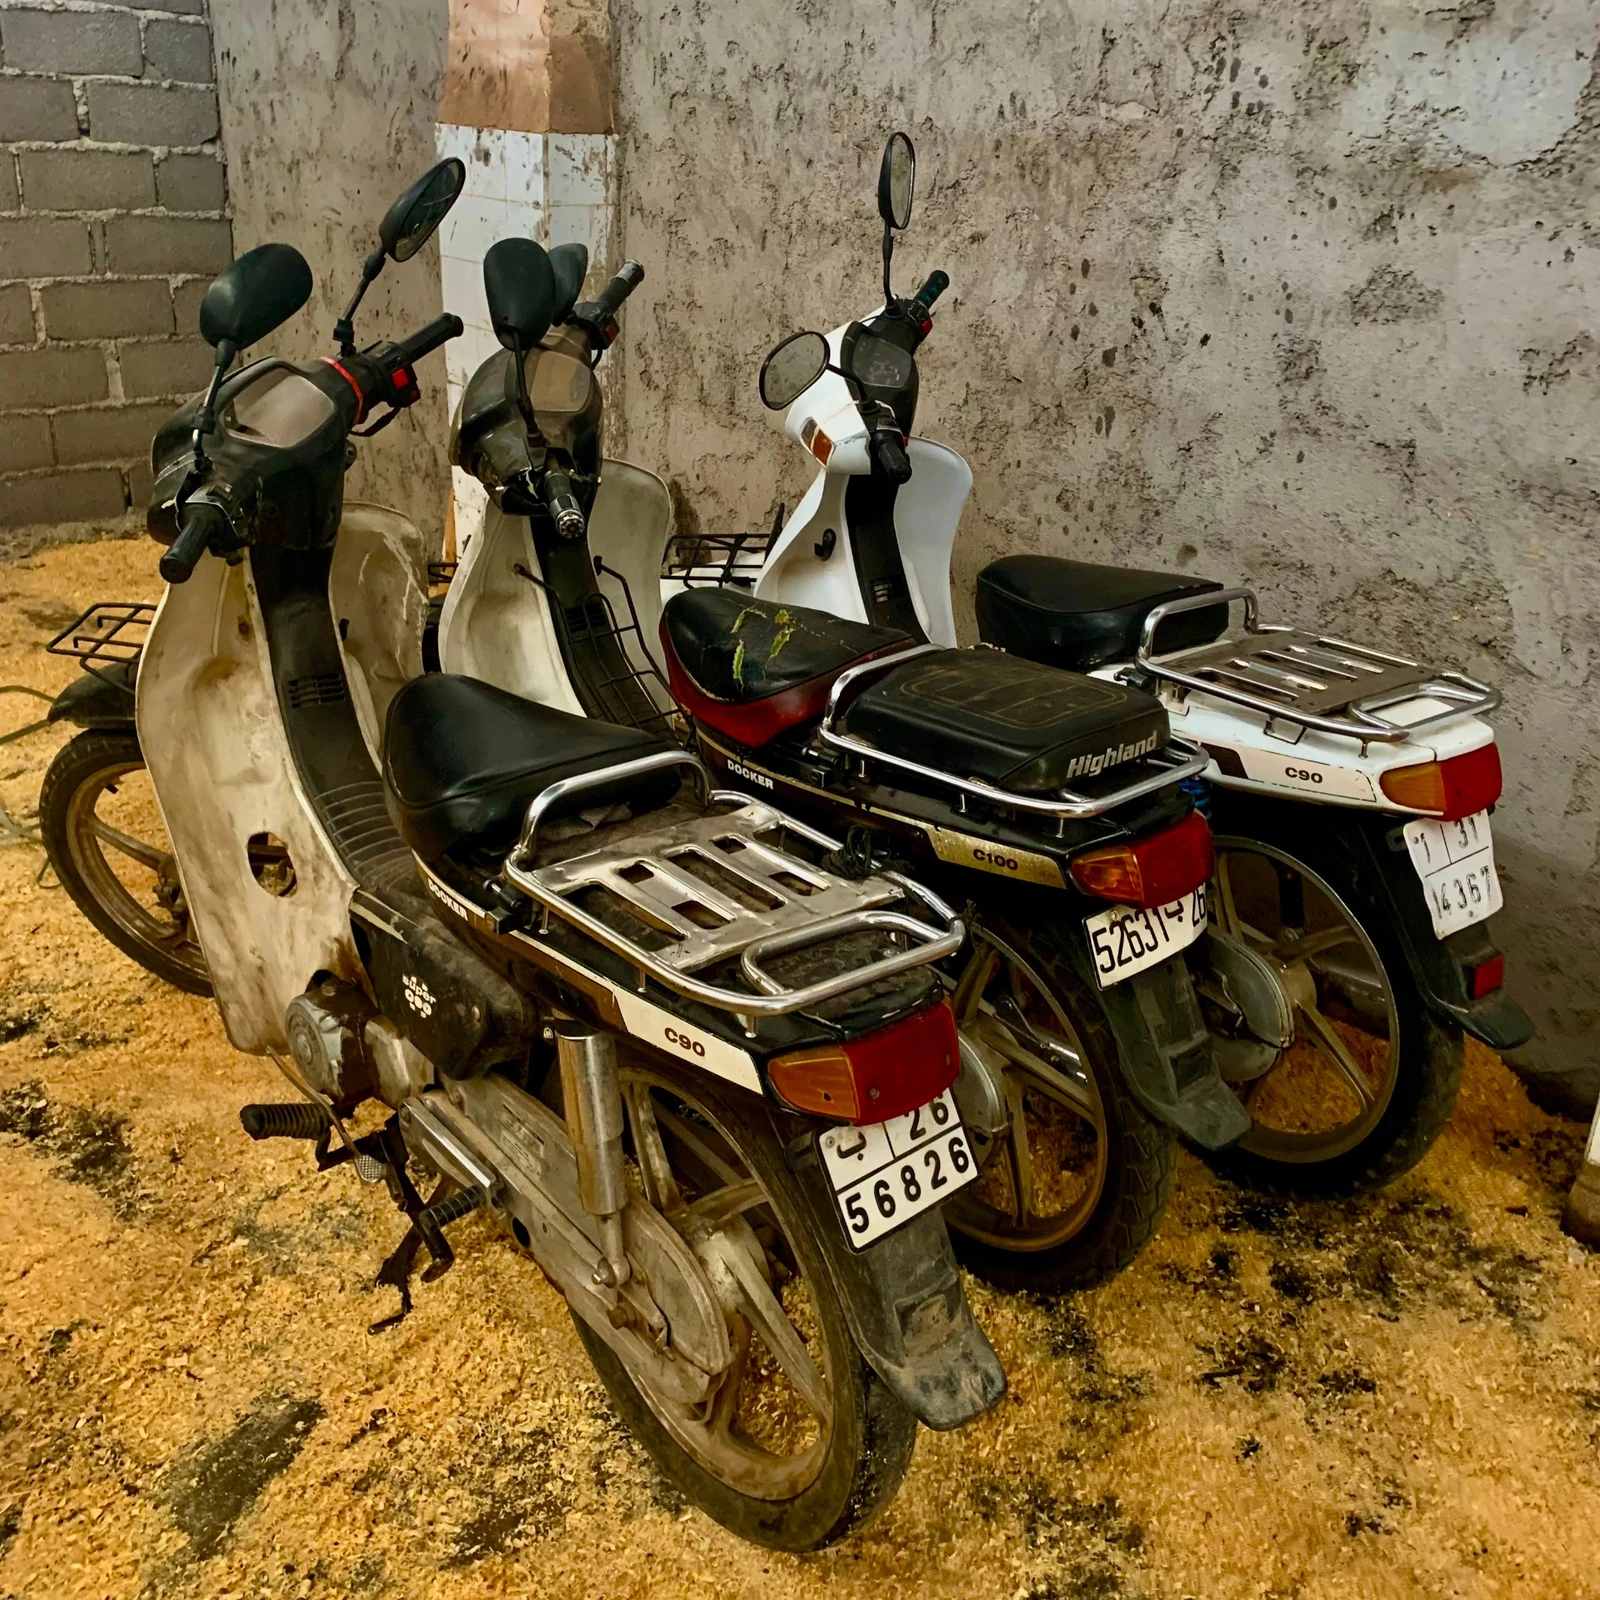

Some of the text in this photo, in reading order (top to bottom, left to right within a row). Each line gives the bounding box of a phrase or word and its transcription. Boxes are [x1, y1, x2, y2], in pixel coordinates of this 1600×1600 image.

[727, 759, 774, 790] DOCKER
[1065, 730, 1158, 779] Highland
[1285, 766, 1323, 784] C90
[973, 848, 1018, 871] C100
[1431, 865, 1492, 920] 14367
[1091, 905, 1170, 974] 52631
[664, 1027, 706, 1057] C90
[904, 1092, 949, 1141] 26
[845, 1136, 970, 1234] 56826
